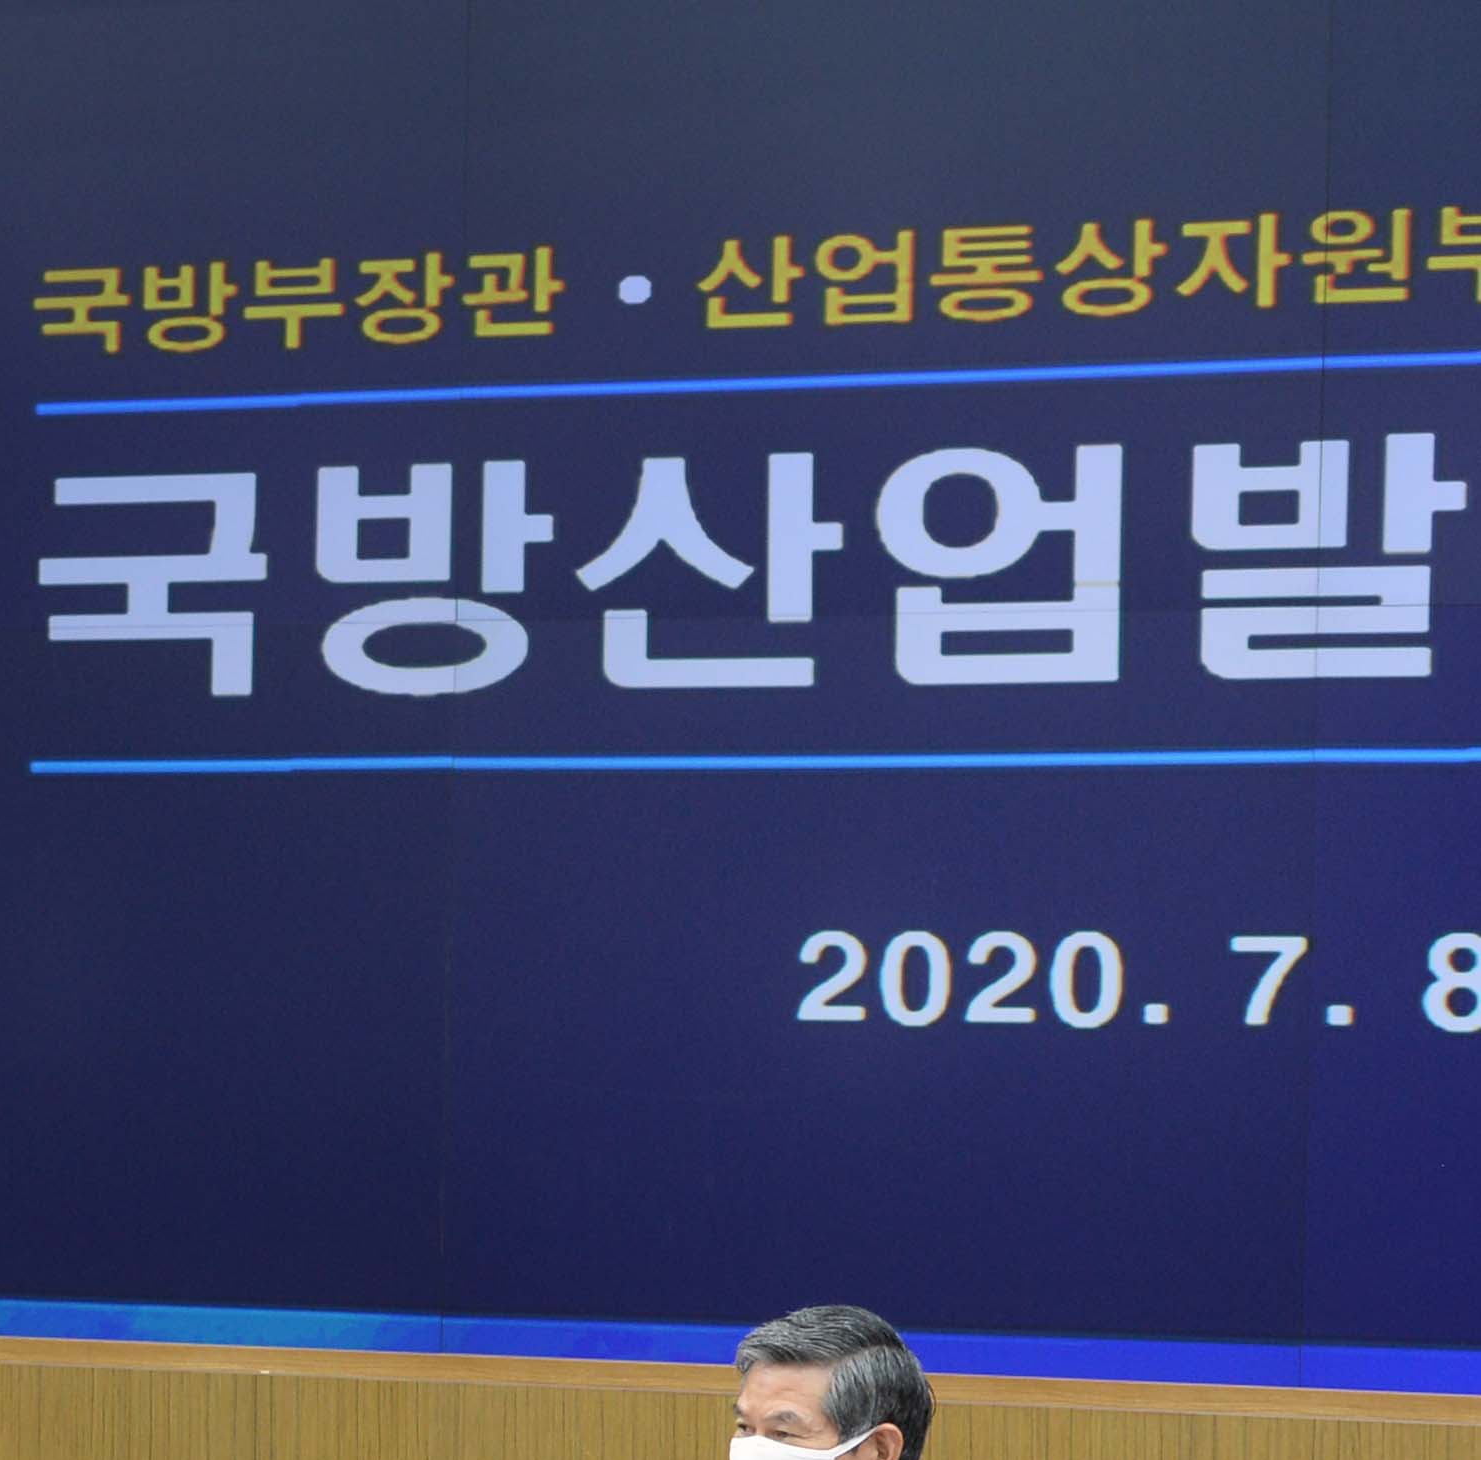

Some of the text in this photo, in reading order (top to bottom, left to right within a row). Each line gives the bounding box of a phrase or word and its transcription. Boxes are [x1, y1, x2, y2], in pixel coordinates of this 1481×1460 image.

[32, 244, 567, 355] 국방부장관
[38, 432, 1468, 697] 국방산업발
[796, 929, 1170, 1029] 2020.
[1229, 935, 1356, 1027] 7.
